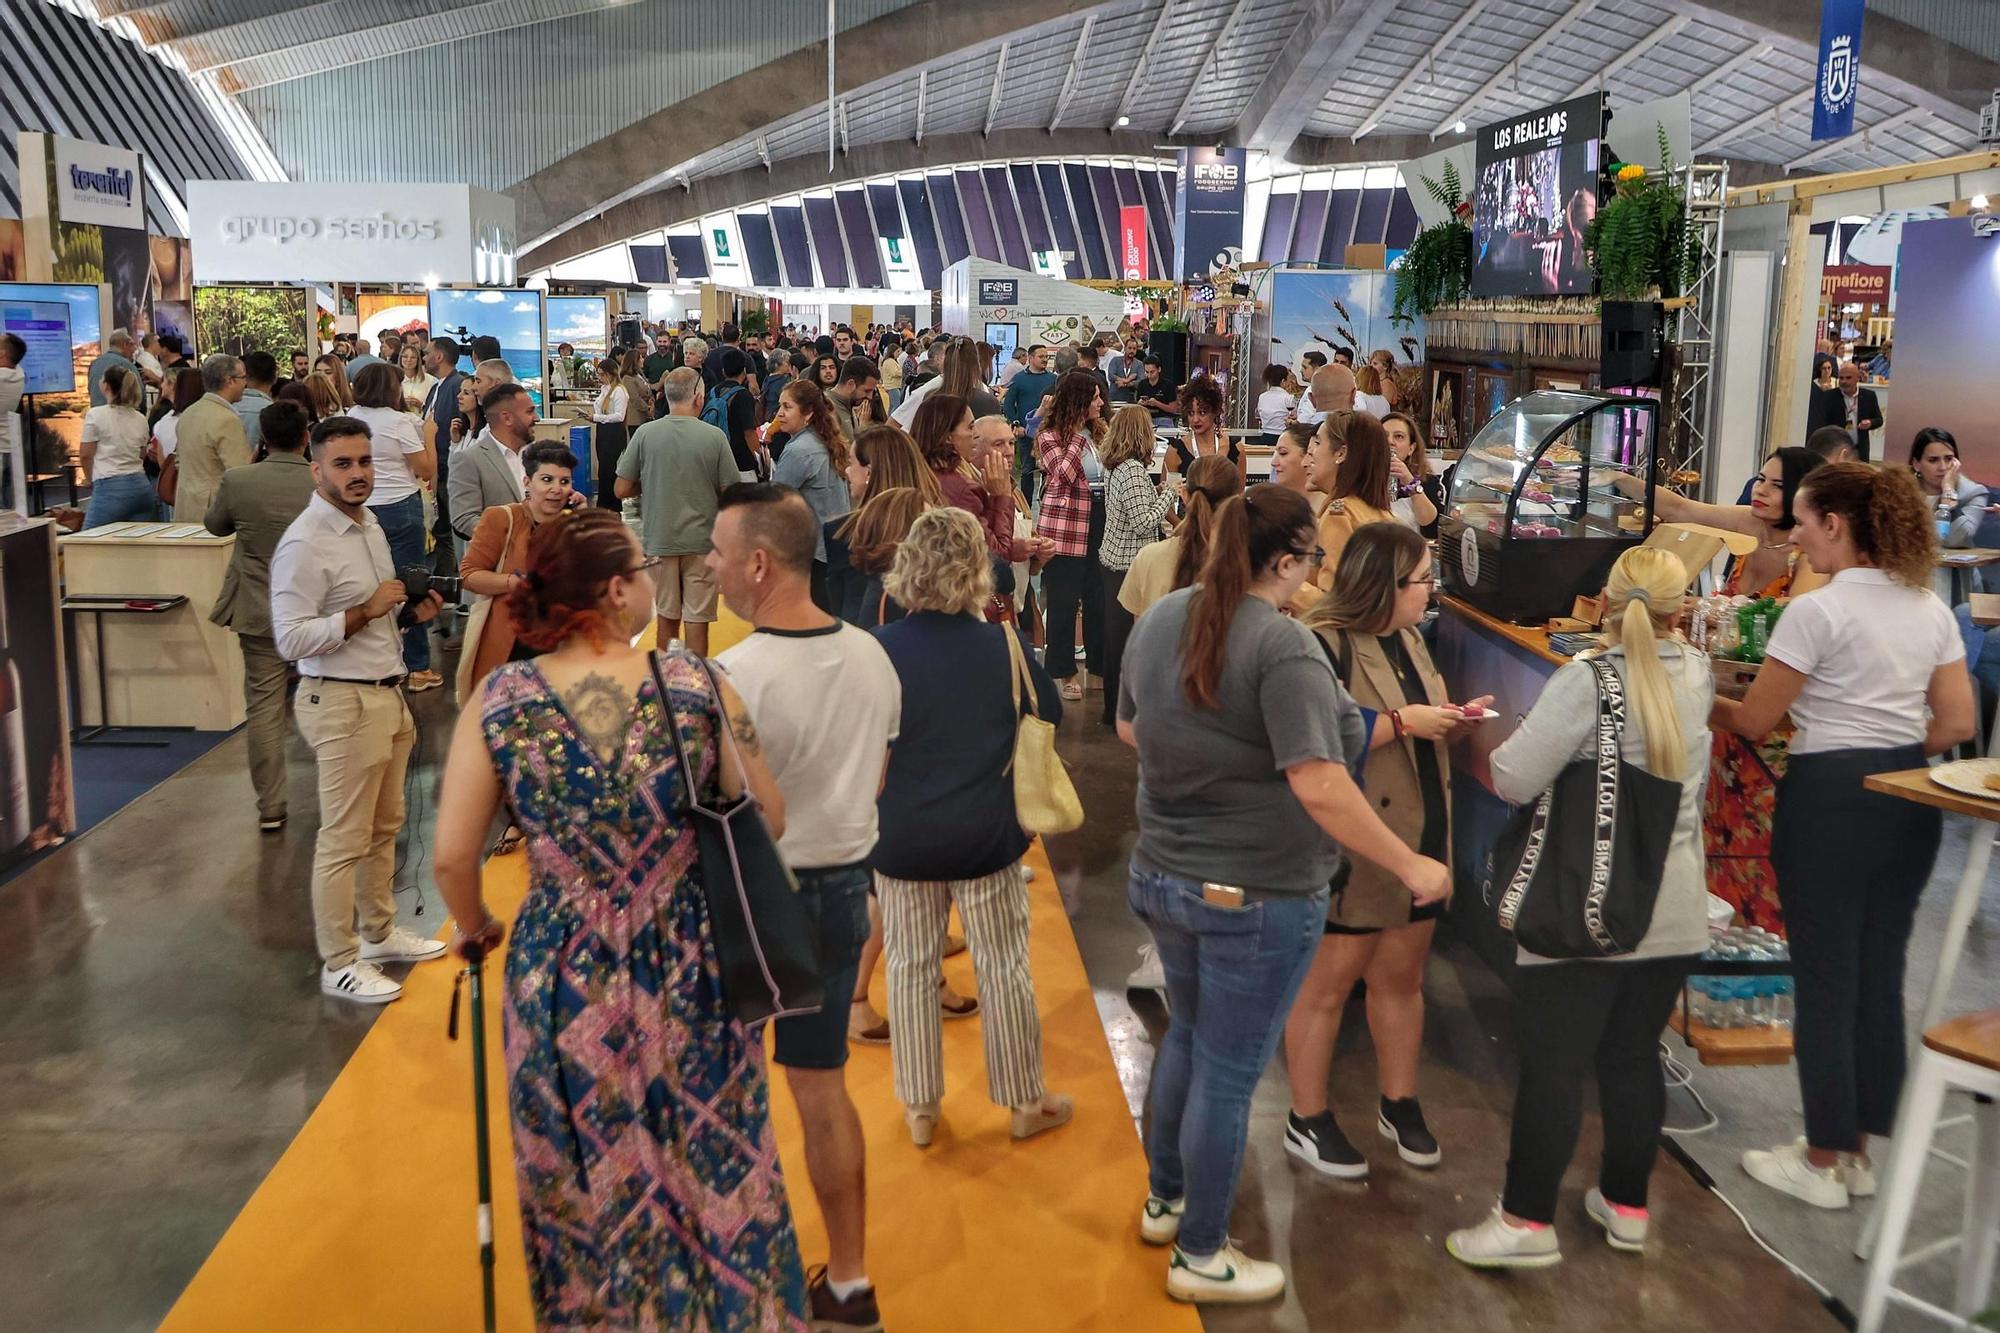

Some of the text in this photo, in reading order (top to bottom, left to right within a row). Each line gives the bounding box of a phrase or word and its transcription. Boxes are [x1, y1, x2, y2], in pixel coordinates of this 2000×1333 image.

[1821, 56, 1858, 113] CABILDO DE TENERIFE
[1494, 111, 1567, 150] LOS REALEJOS
[1194, 164, 1238, 180] IFOB
[222, 215, 320, 244] grupo
[983, 281, 1013, 293] IFOB
[979, 308, 993, 319] We
